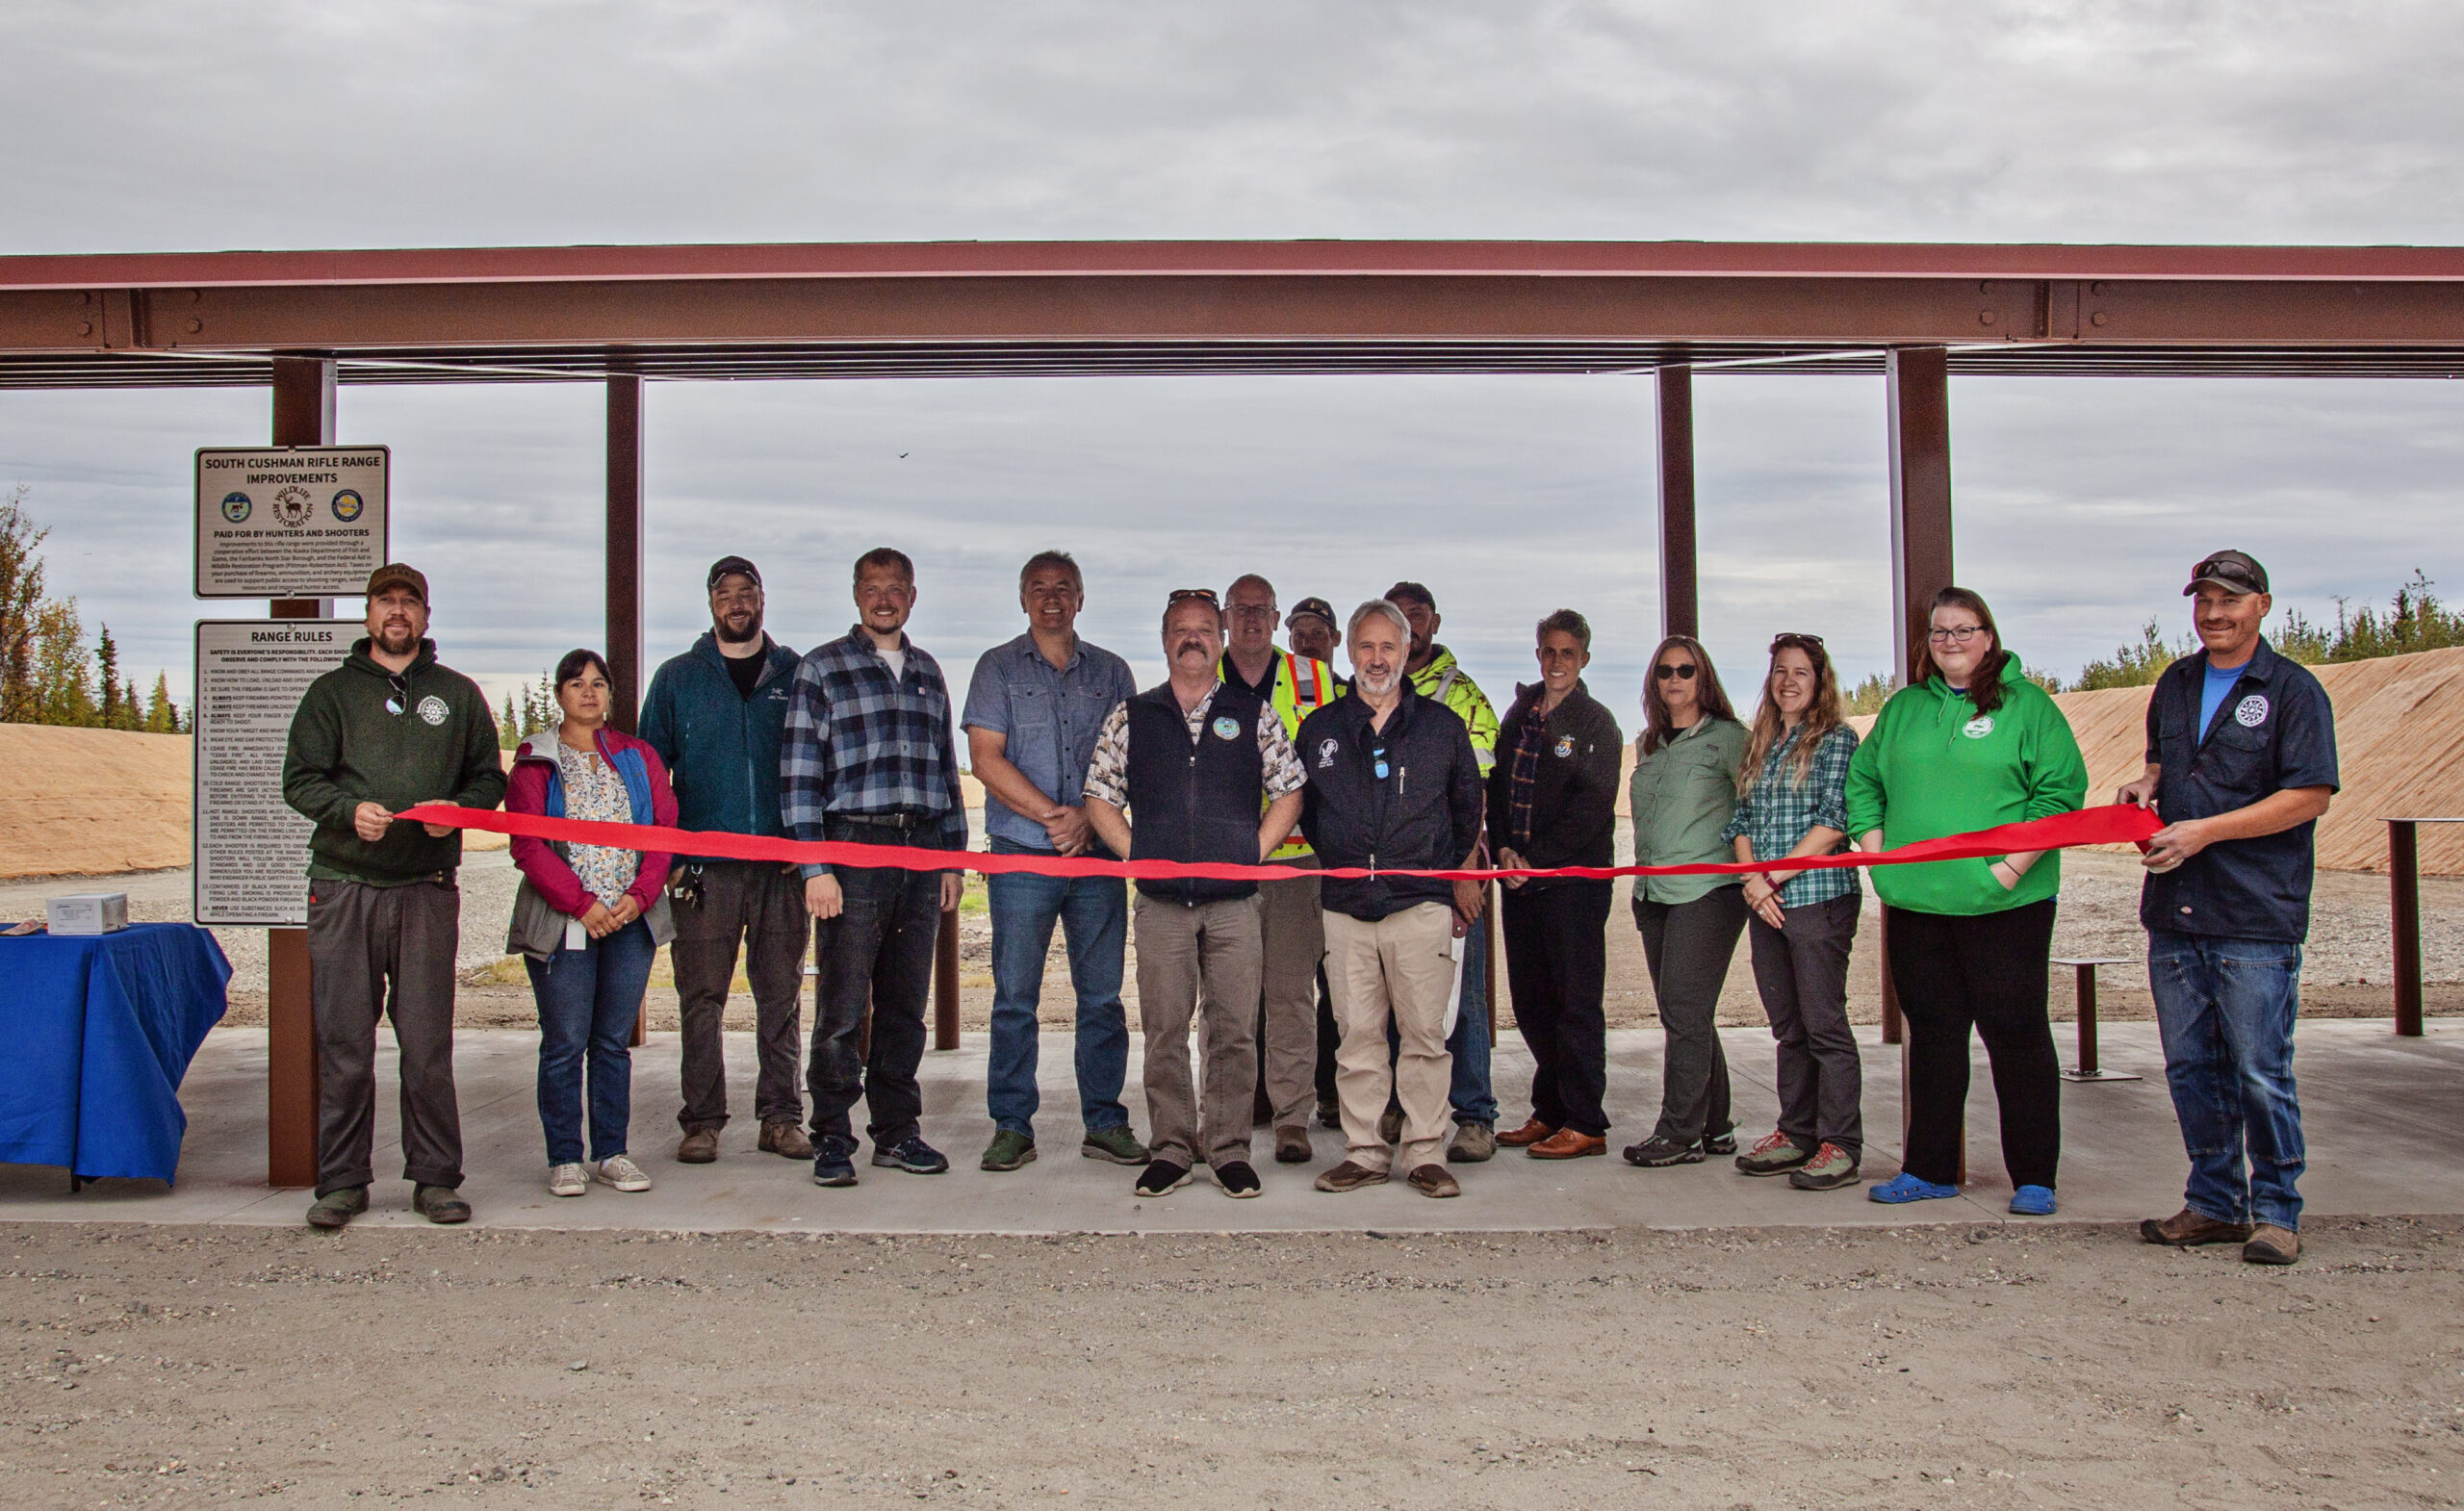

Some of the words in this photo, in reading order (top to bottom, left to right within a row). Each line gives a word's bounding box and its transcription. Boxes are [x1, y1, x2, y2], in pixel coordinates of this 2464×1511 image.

[205, 459, 244, 468] SOUTH
[247, 458, 304, 468] CUSHMAN
[307, 457, 338, 467] RIFLE
[342, 457, 380, 466] RANGE
[247, 473, 336, 483] IMPROVEMENTS
[275, 486, 311, 501] WILDLIFE
[273, 503, 313, 528] RESTORATION
[252, 632, 290, 642] RANGE
[294, 631, 331, 641] RULES
